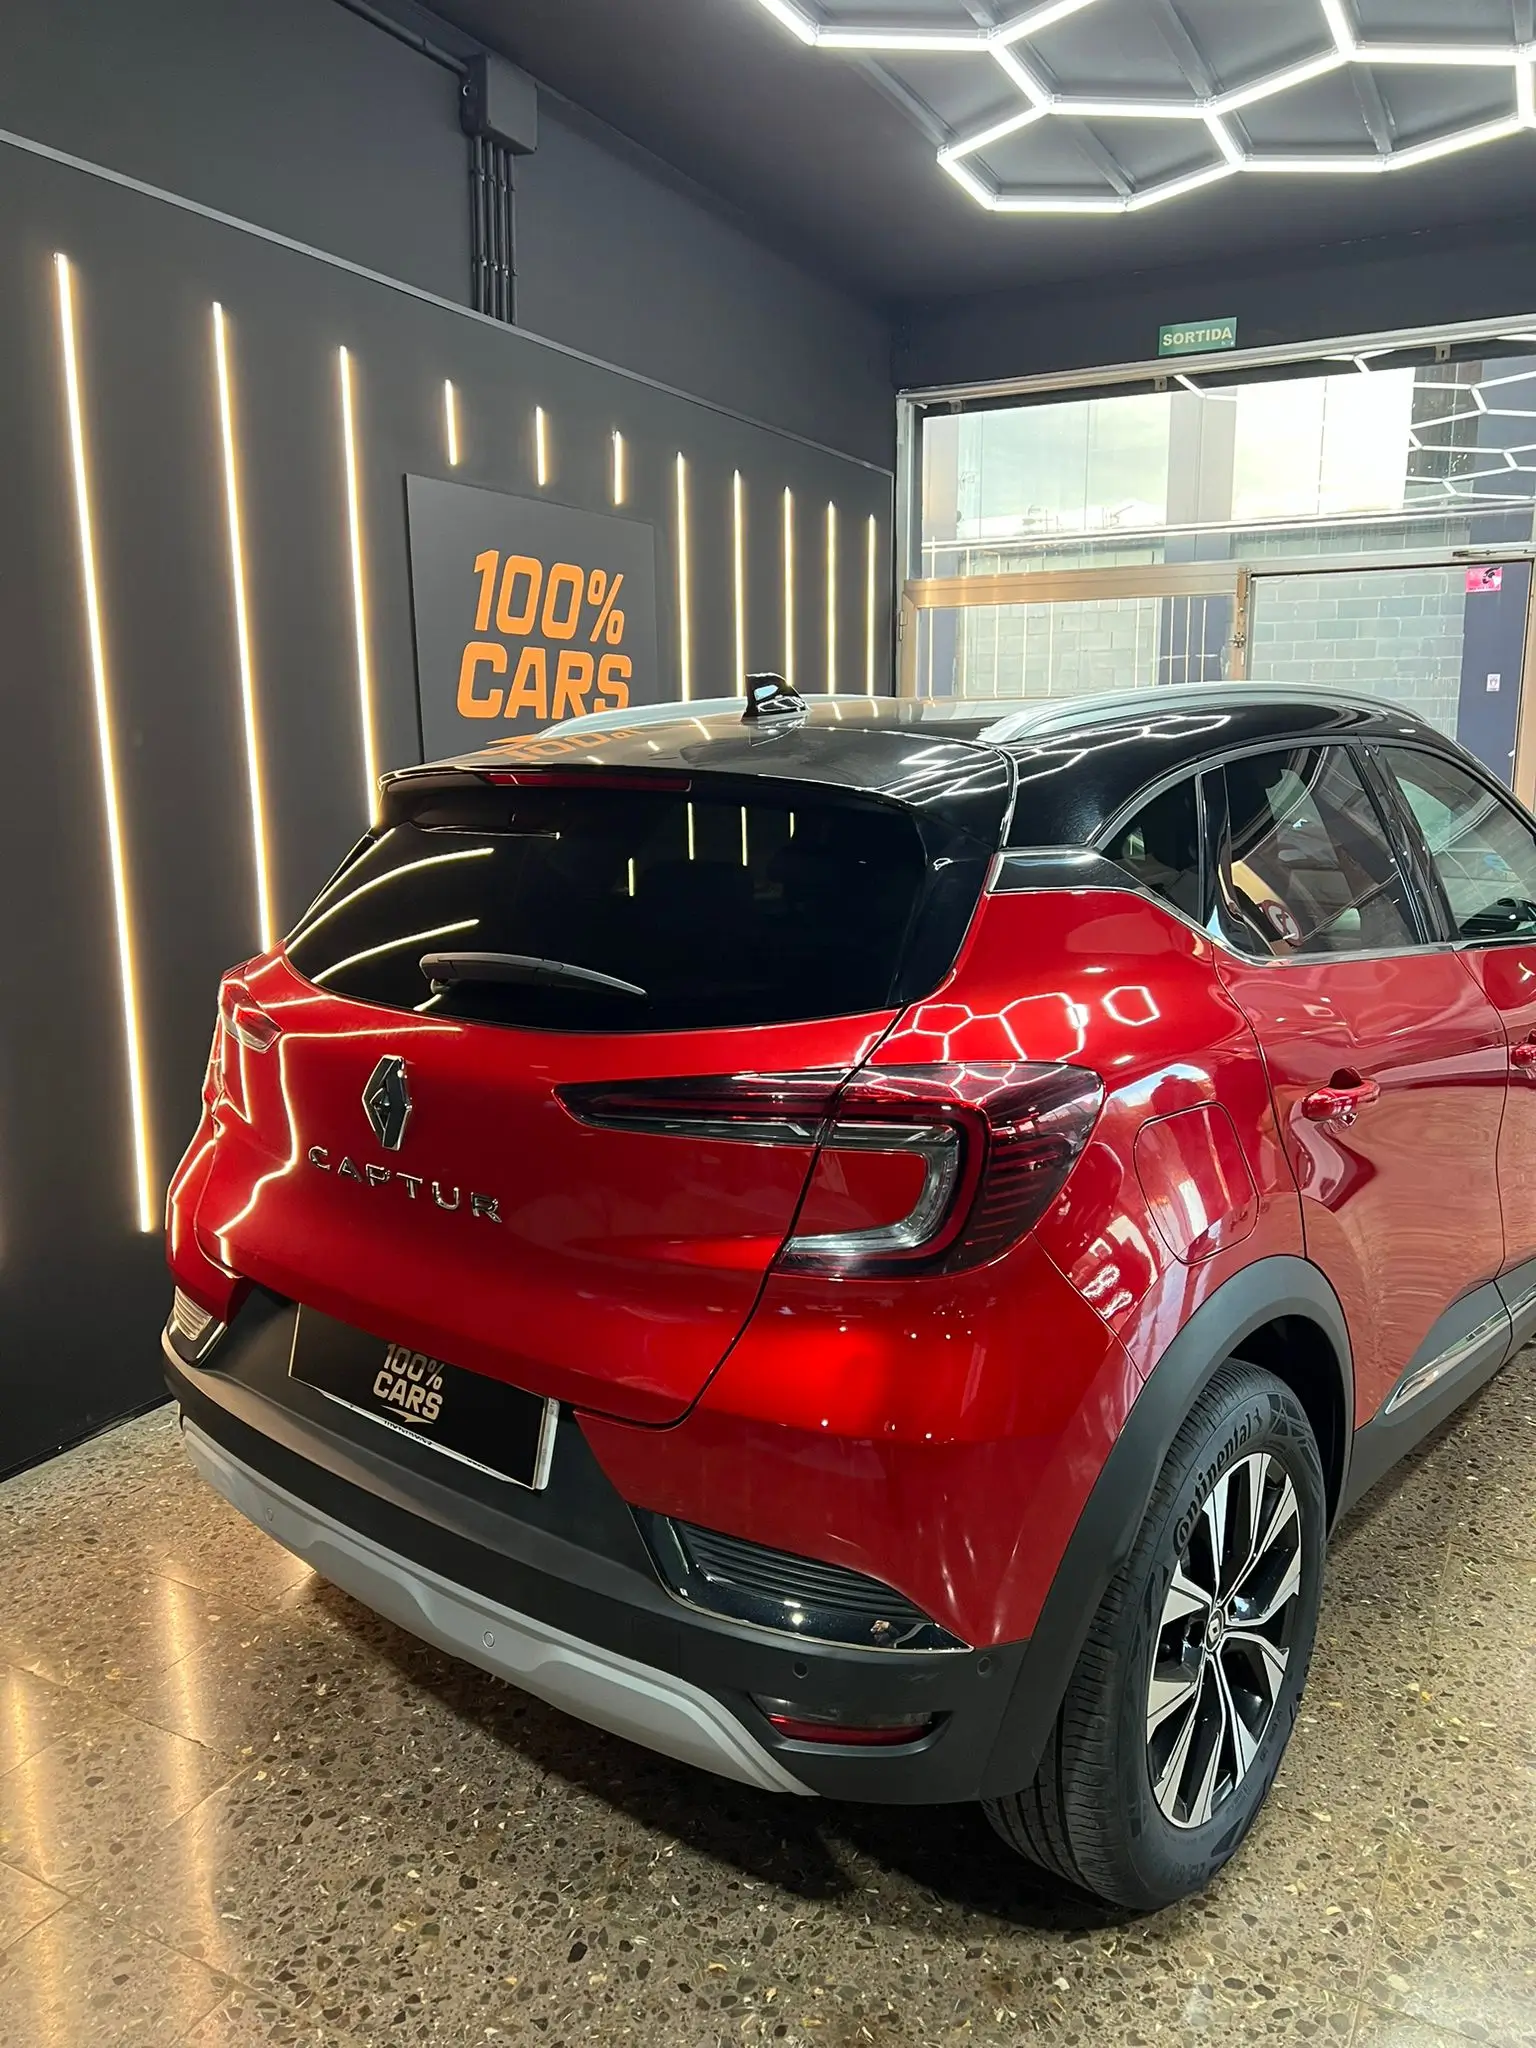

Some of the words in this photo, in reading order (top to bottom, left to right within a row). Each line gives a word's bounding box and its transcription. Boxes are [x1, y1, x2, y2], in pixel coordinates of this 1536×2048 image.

[1162, 326, 1233, 347] SORTIDA
[473, 549, 625, 646] 100%
[456, 641, 633, 720] CARS
[308, 1145, 503, 1223] CAPTUR
[373, 1370, 444, 1421] CARS
[383, 1343, 445, 1391] 100%
[1172, 1411, 1251, 1557] Continental
